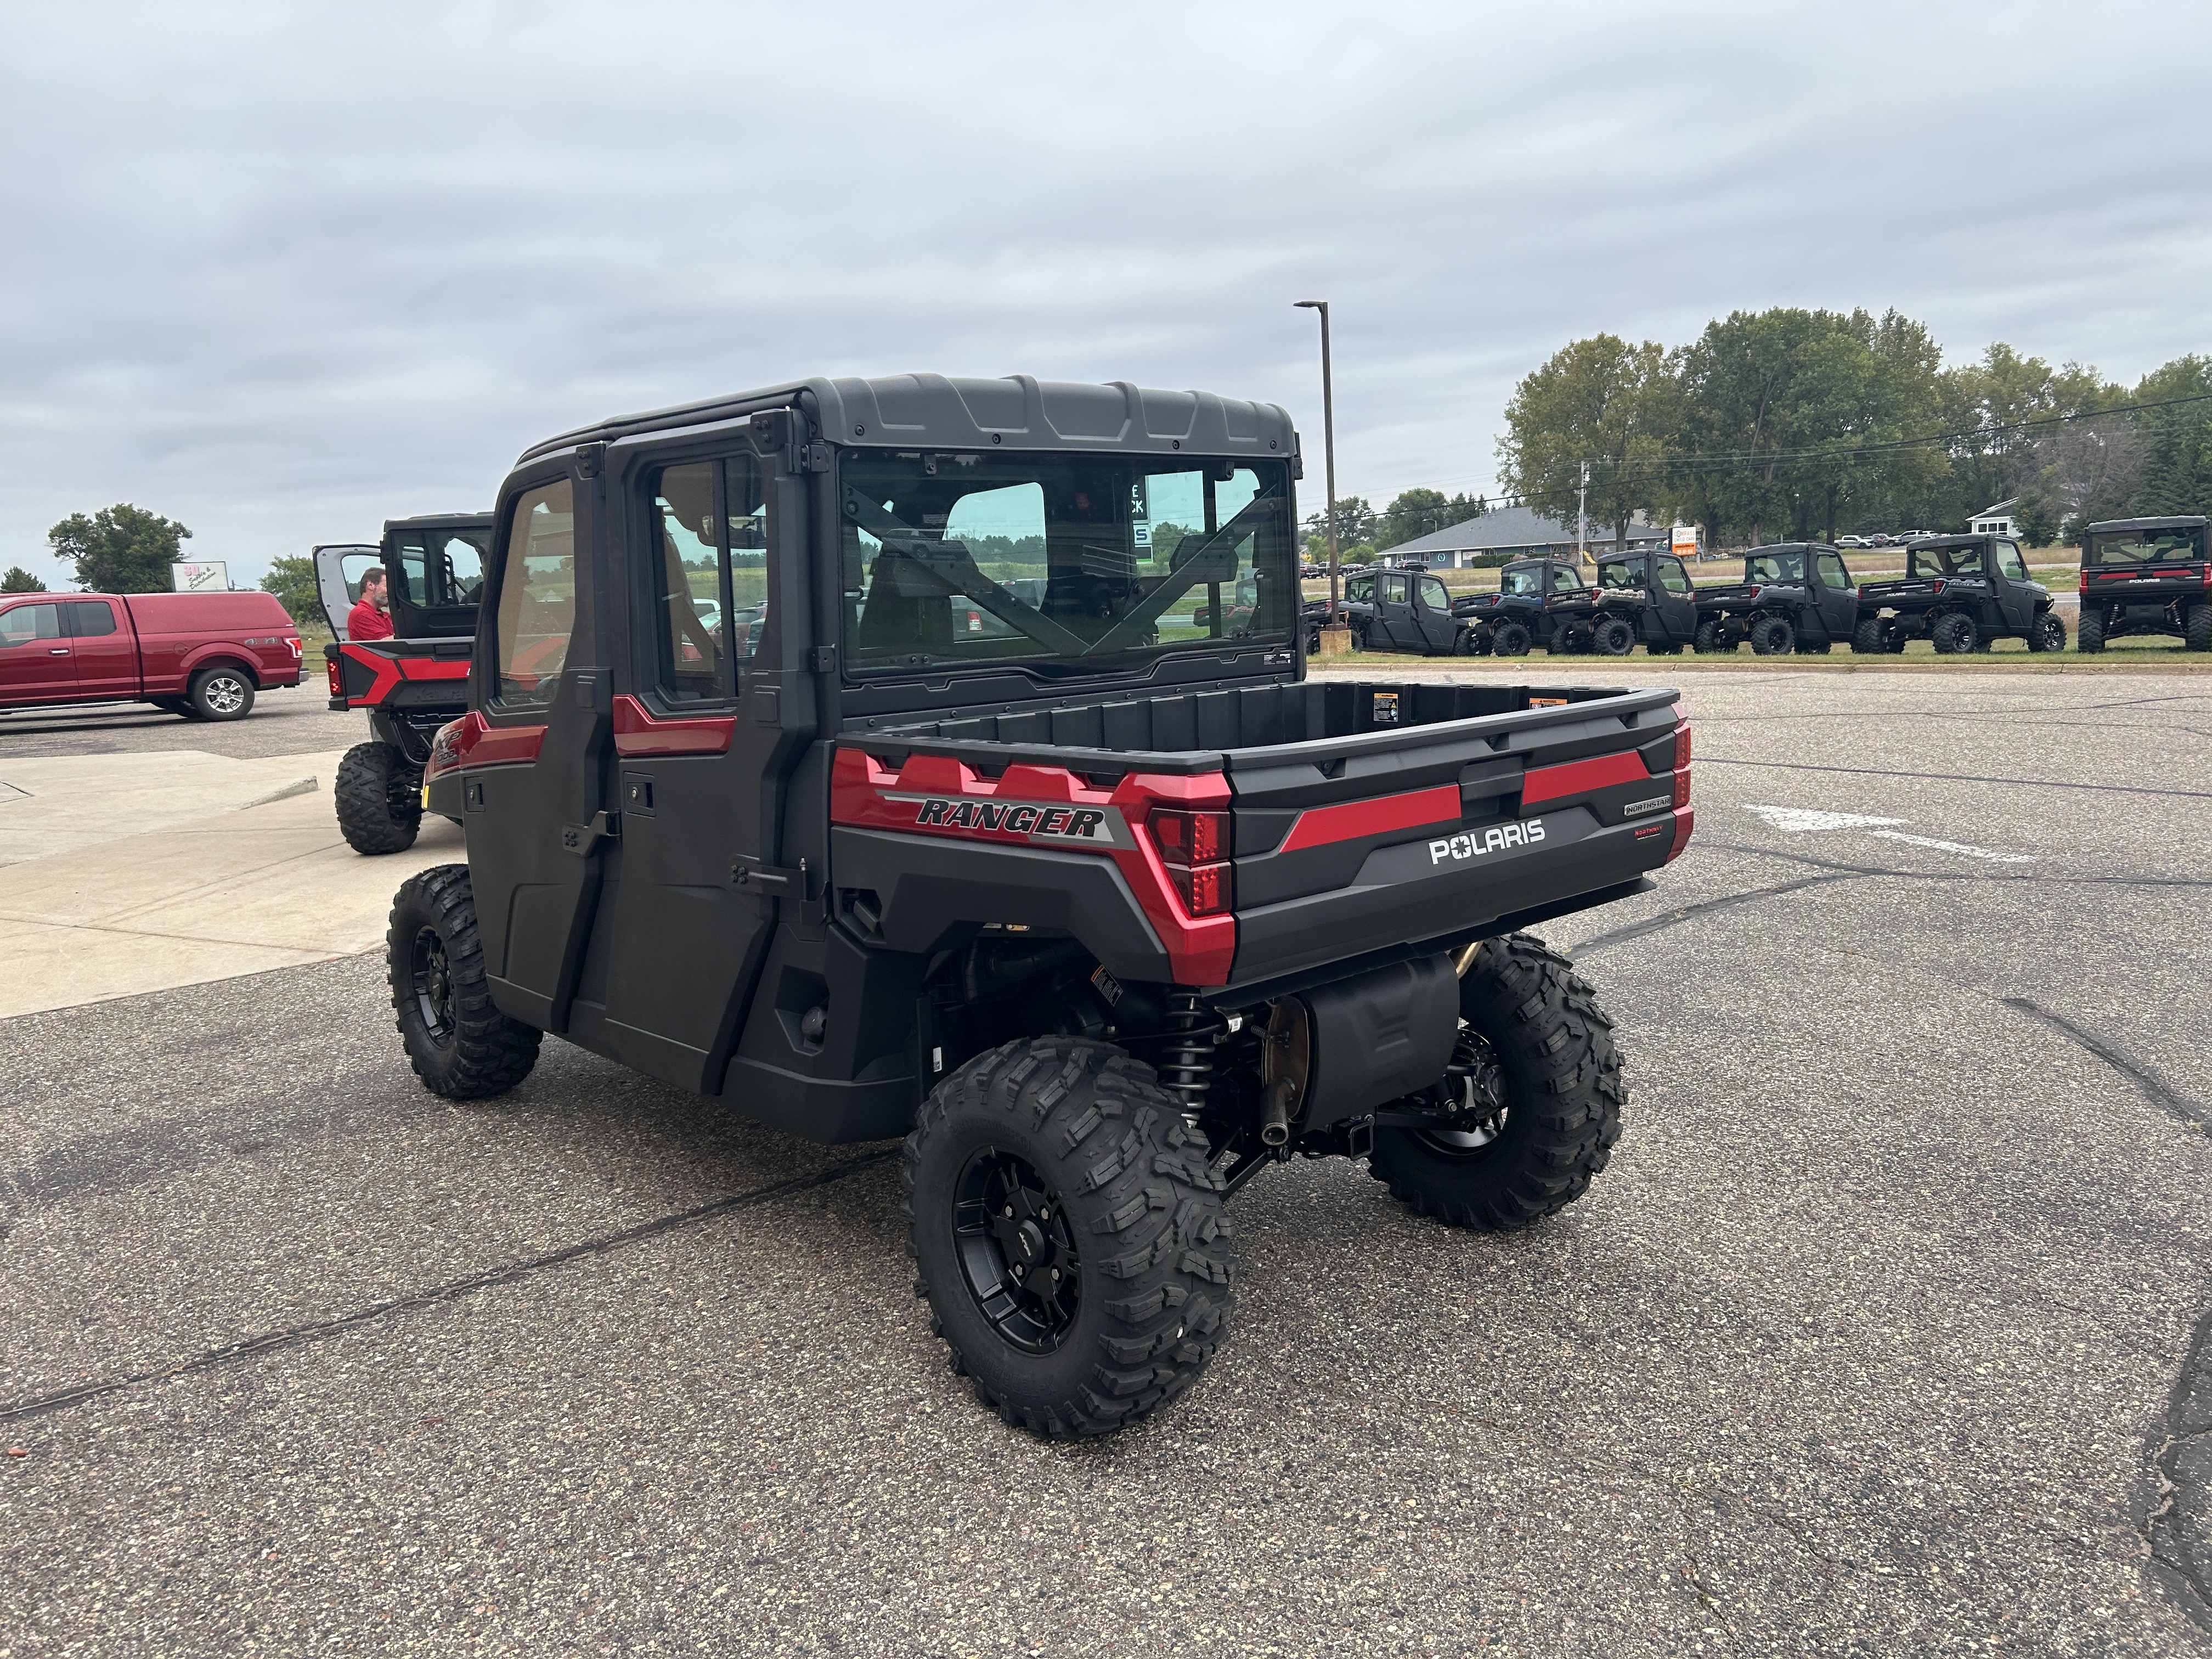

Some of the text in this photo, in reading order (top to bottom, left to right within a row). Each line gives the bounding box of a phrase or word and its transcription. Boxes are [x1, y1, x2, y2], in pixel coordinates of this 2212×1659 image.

[433, 729, 463, 753] XP
[916, 799, 1105, 837] RANGER
[1628, 798, 1669, 814] NORTHSTAR
[1428, 819, 1545, 865] POLARIS
[1635, 825, 1663, 836] NORTHWAY
